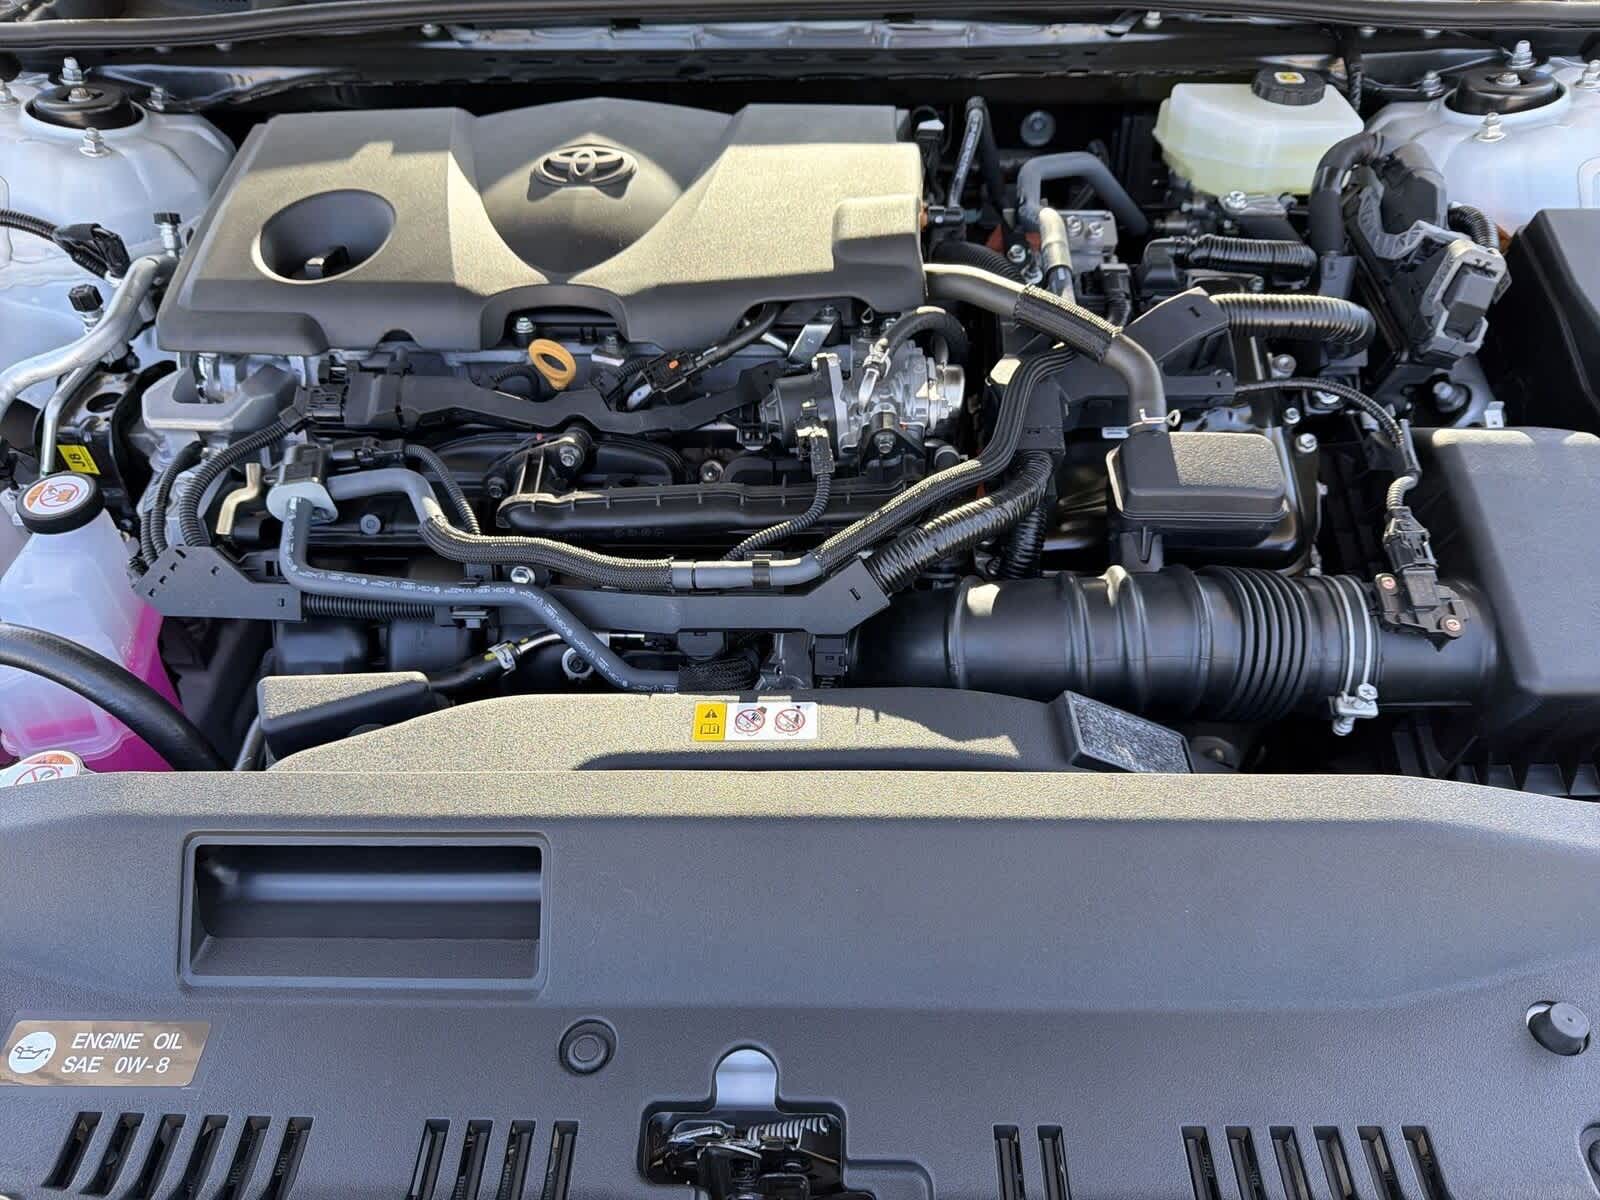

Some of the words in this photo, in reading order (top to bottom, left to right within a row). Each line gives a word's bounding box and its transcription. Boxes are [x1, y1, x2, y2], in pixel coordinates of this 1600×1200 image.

[71, 1032, 144, 1049] ENGINE
[153, 1032, 183, 1050] OIL
[61, 1056, 104, 1074] SAE
[114, 1056, 171, 1074] 0W-8
